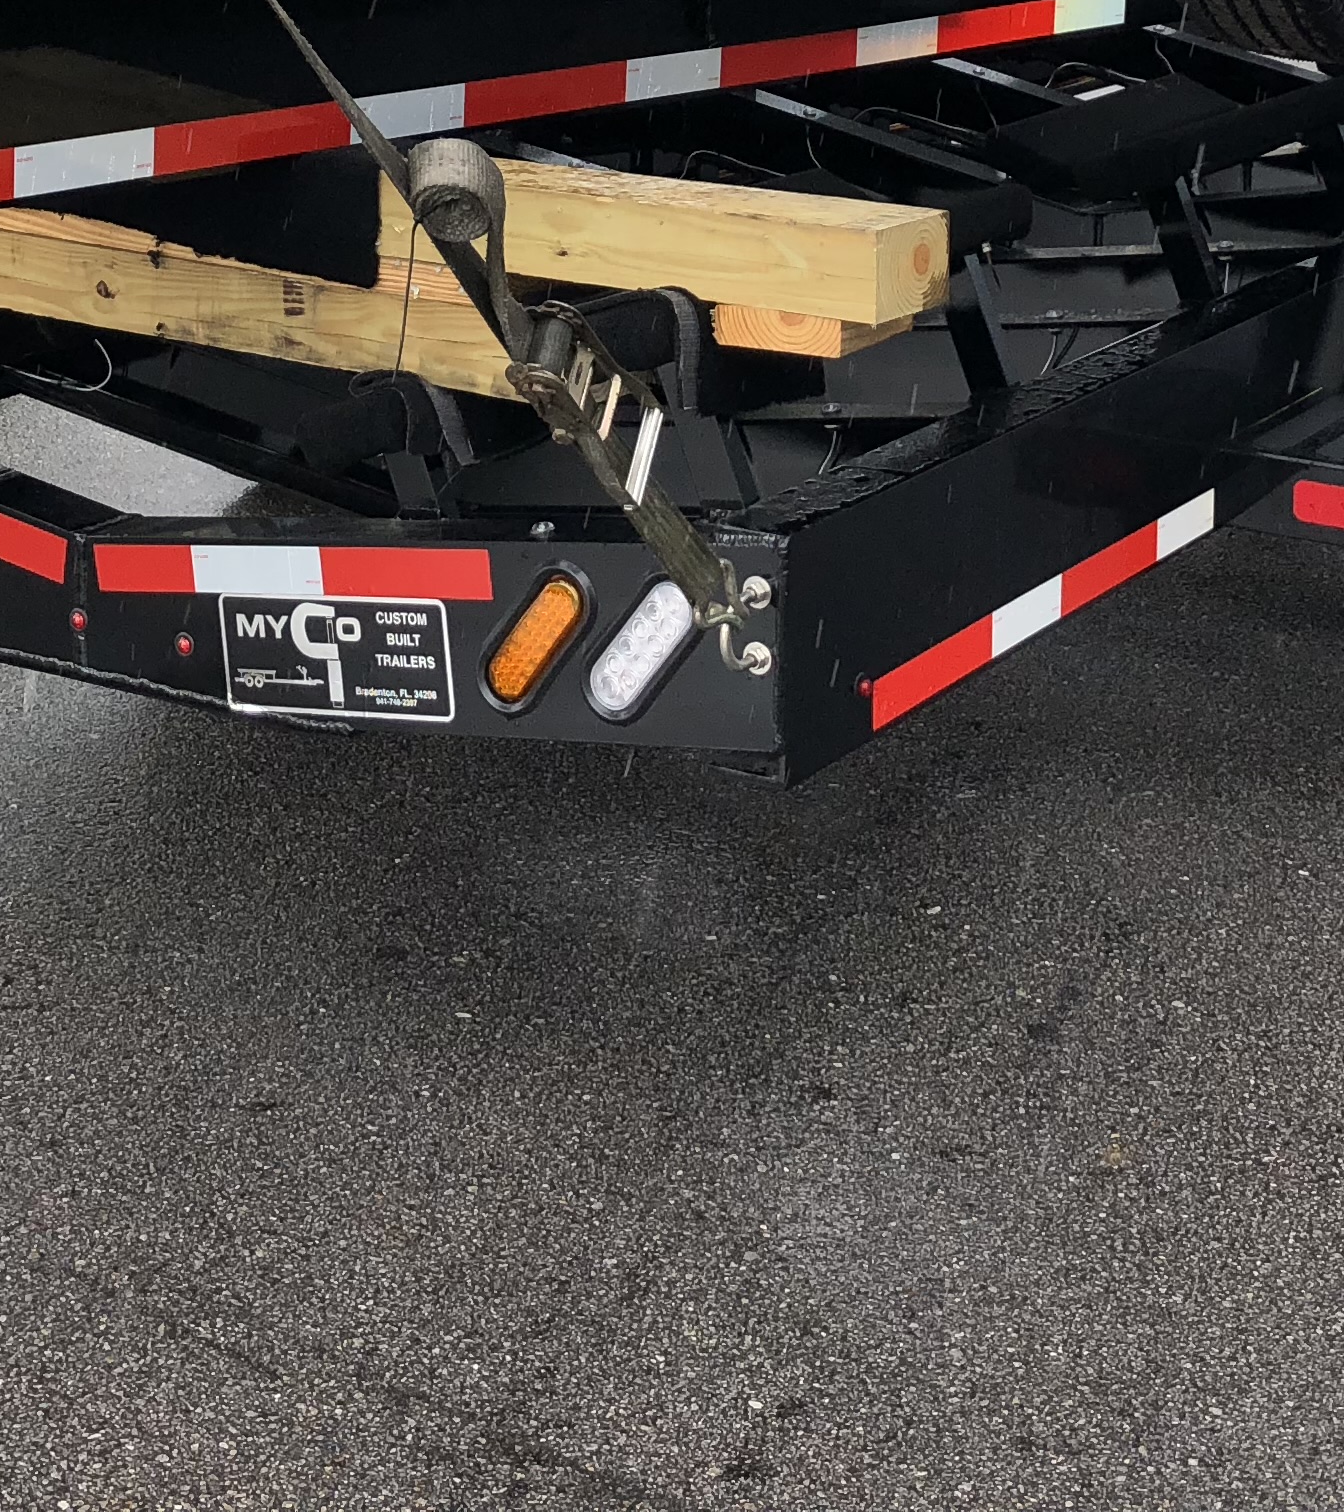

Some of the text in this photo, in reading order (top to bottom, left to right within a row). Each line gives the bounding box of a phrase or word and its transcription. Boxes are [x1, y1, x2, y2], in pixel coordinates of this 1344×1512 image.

[375, 611, 428, 626] CUSTOM
[386, 633, 421, 647] BUILT
[375, 653, 436, 669] TRAILERS
